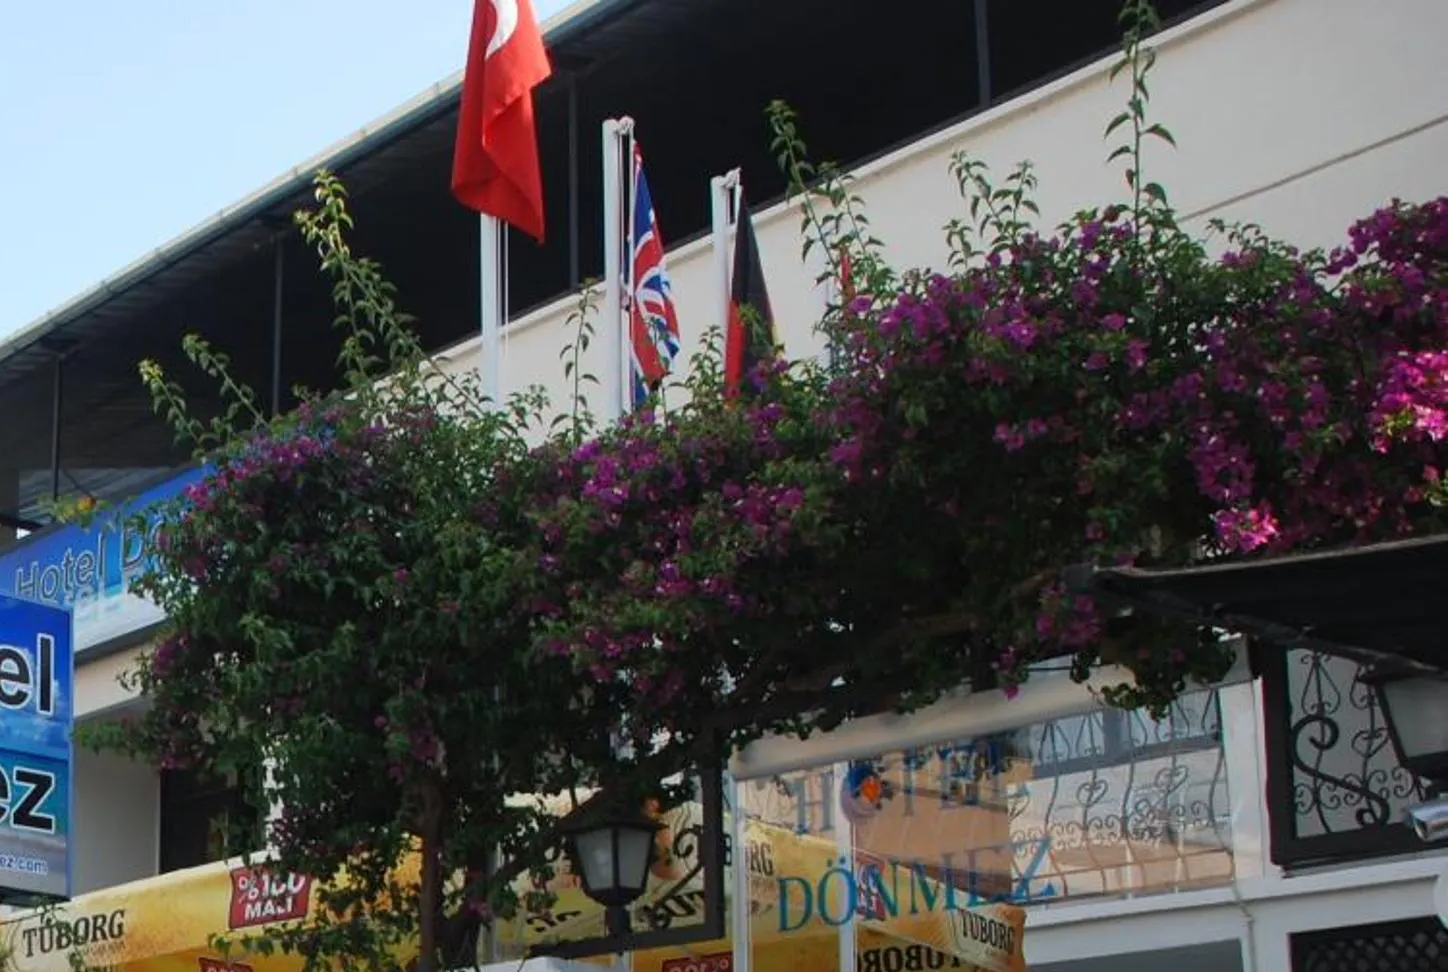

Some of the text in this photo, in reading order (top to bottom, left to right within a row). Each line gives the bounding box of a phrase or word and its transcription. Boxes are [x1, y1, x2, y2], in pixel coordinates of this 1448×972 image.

[15, 532, 105, 600] Hotel
[776, 836, 1056, 932] DÖNMEZ
[22, 909, 127, 958] TUBORG
